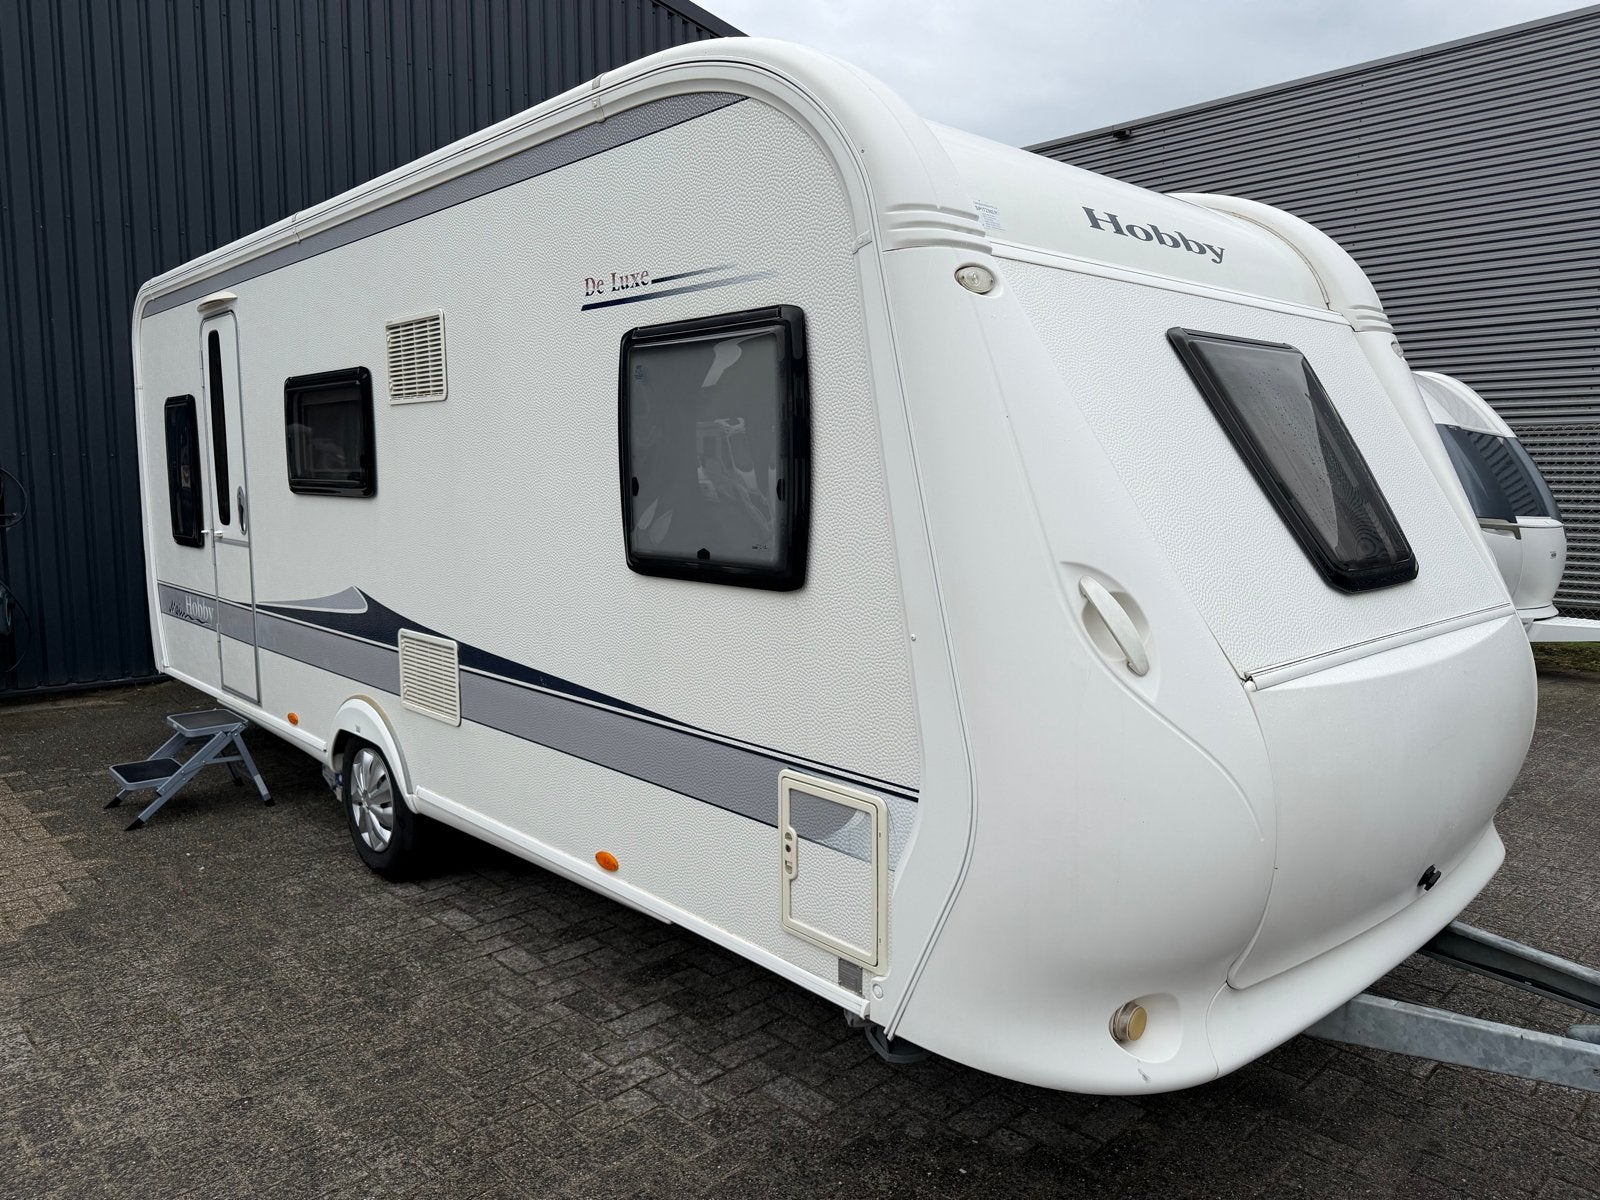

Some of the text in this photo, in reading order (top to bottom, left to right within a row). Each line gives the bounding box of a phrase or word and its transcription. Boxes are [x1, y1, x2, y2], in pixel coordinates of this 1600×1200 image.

[1082, 206, 1226, 264] Hobby
[584, 270, 649, 297] De Luxe
[185, 595, 214, 625] Hobby
